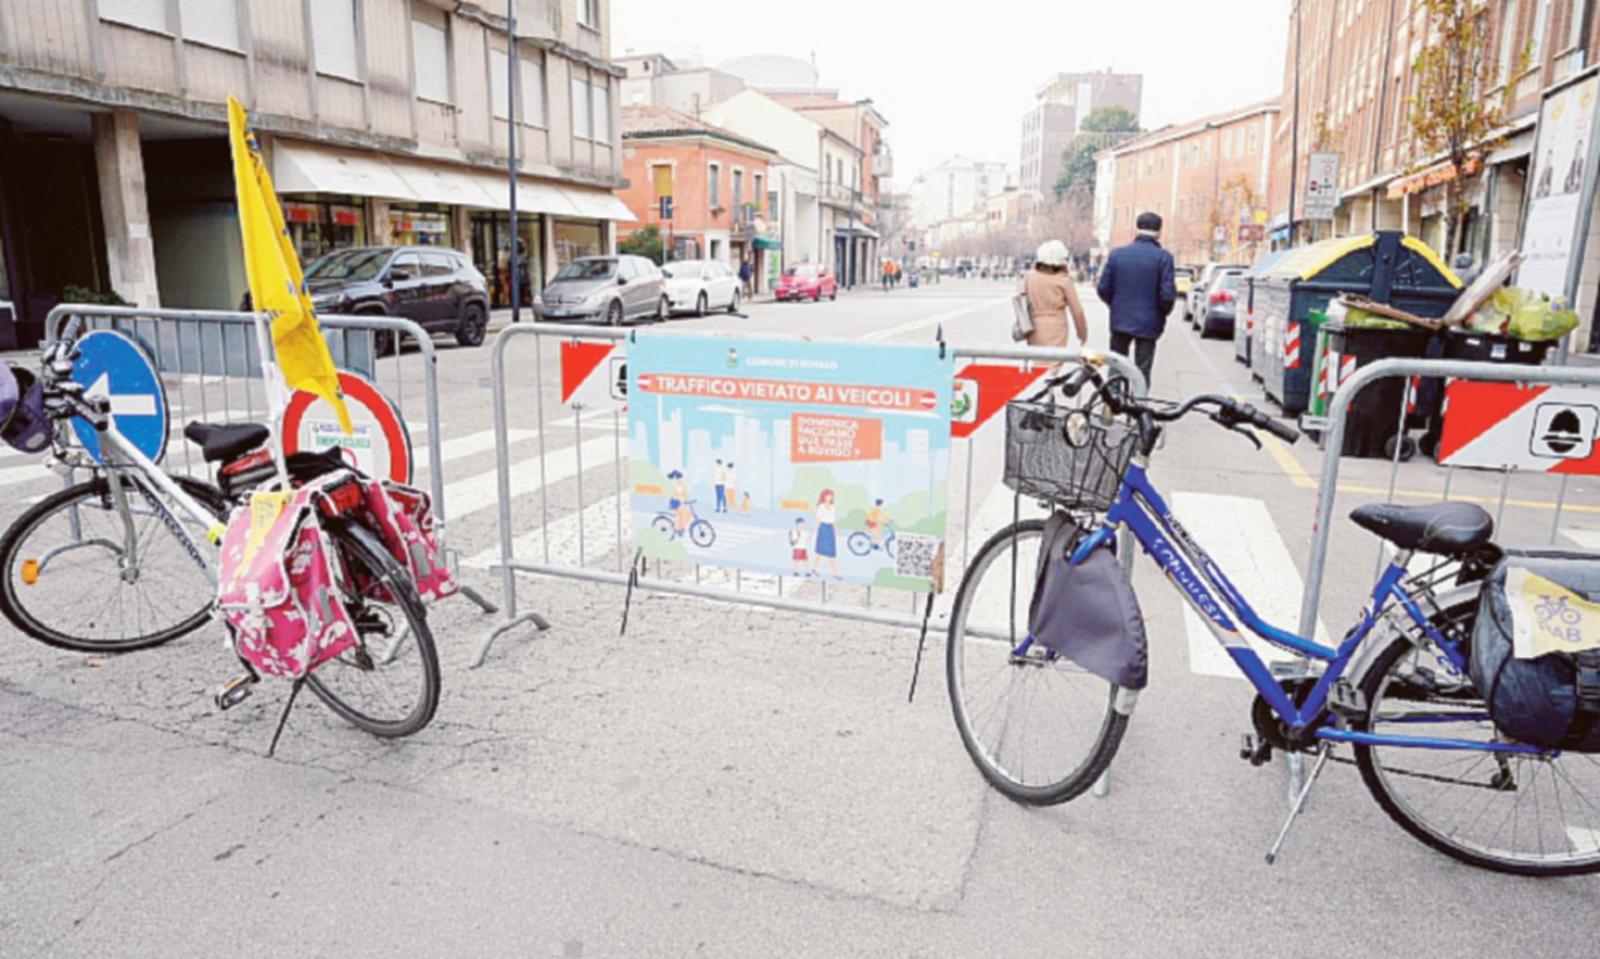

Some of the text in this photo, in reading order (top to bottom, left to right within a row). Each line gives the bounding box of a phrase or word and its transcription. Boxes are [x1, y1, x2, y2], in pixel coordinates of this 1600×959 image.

[658, 376, 910, 406] TRAFFICO VIETATO AI VEICOLI
[799, 416, 858, 429] DOMENICA
[799, 427, 856, 439] FACCIAMO
[799, 435, 853, 448] DUE PASSI
